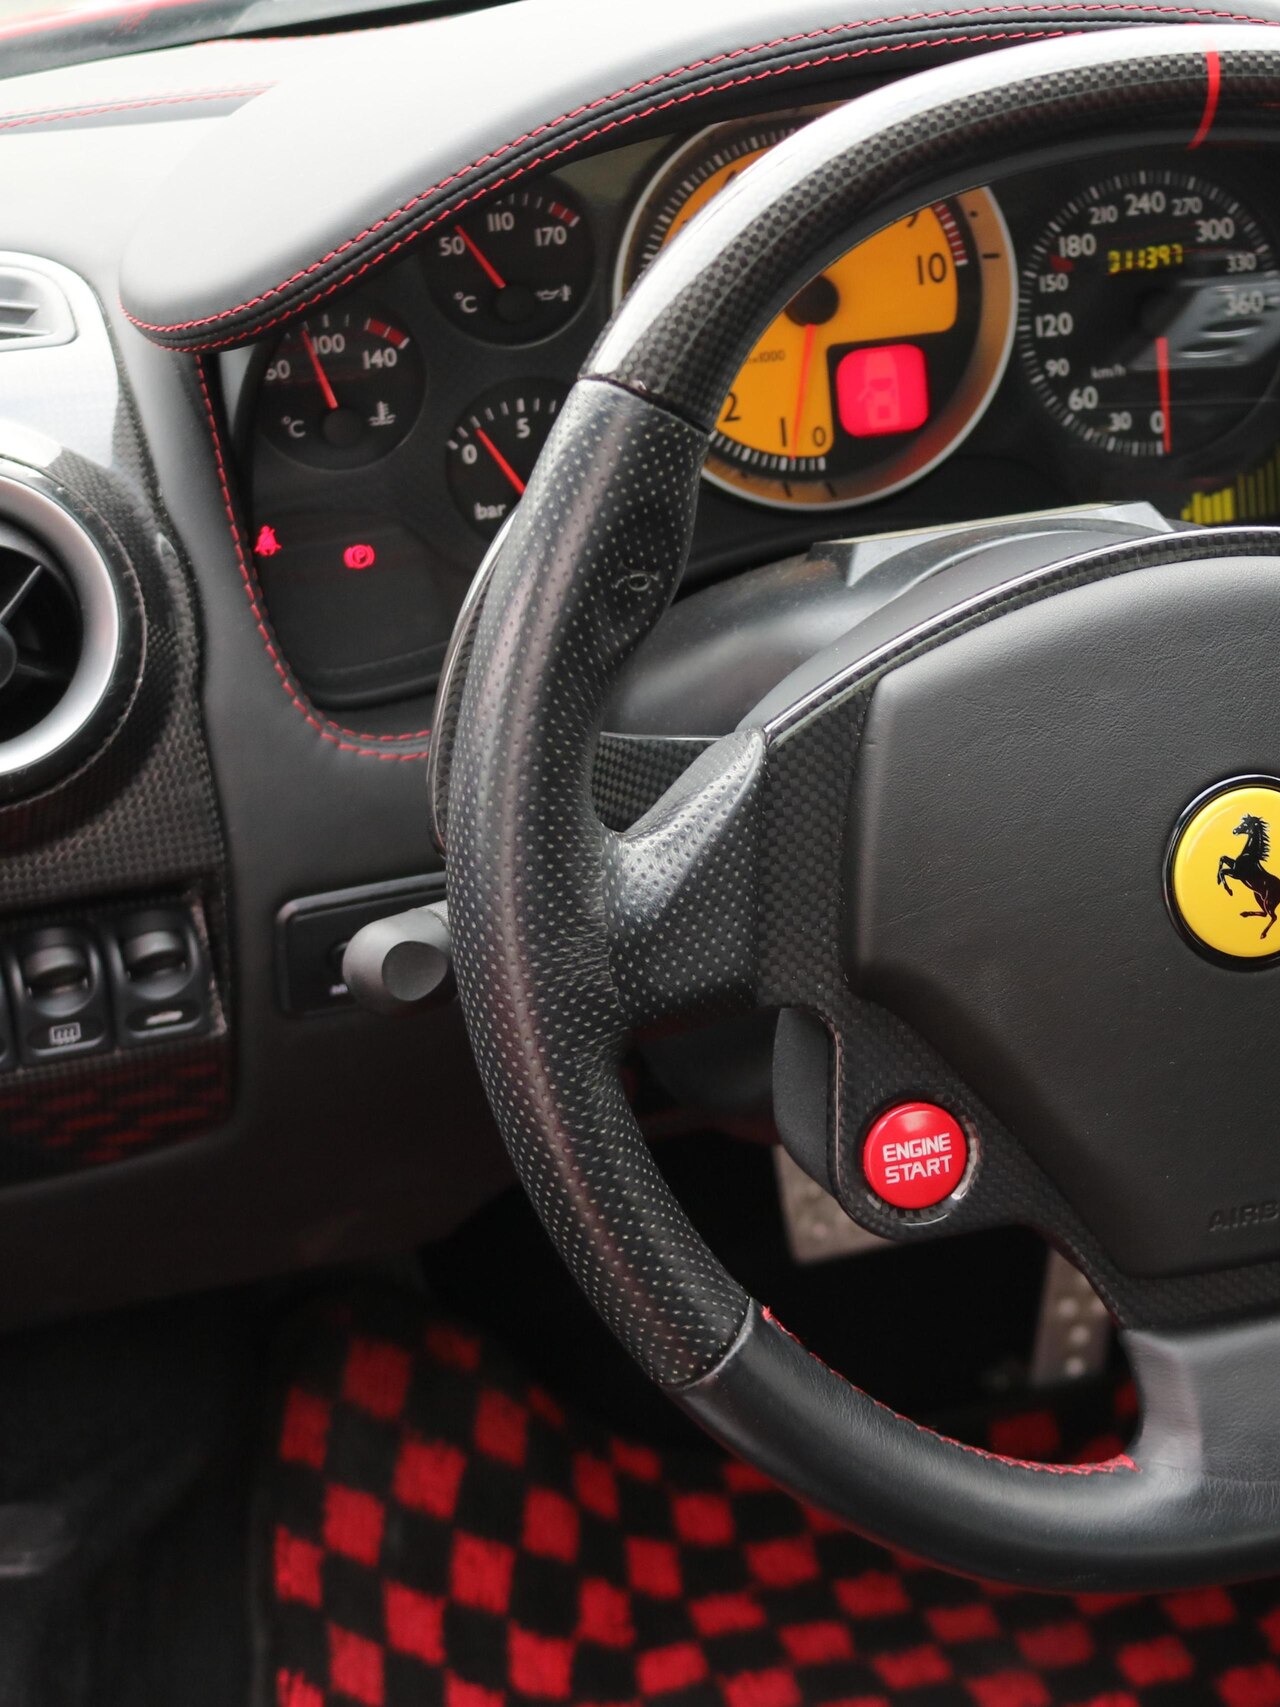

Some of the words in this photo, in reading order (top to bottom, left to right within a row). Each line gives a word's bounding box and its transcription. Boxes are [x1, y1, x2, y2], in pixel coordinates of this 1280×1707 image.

[1125, 191, 1166, 216] 240
[1172, 197, 1203, 215] 270
[487, 211, 514, 232] 110
[1090, 205, 1118, 225] 210
[535, 226, 567, 247] 170
[1196, 218, 1234, 242] 300
[439, 235, 466, 256] 50
[1058, 233, 1096, 257] 180
[917, 252, 947, 285] 10
[1226, 254, 1257, 272] 330
[1040, 274, 1068, 292] 150
[1225, 290, 1265, 316] 360
[1035, 312, 1073, 338] 120
[312, 333, 345, 354] 100
[363, 347, 398, 370] 140
[1046, 358, 1069, 377] 90
[1091, 364, 1126, 379] km/h
[723, 391, 742, 423] 2
[1068, 386, 1098, 411] 60
[516, 417, 531, 439] 5
[780, 416, 788, 448] 1
[1109, 411, 1132, 431] 30
[1150, 410, 1165, 433] 0
[812, 426, 827, 448] 0
[462, 443, 478, 465] 0
[474, 502, 507, 520] bar
[882, 1132, 952, 1162] ENGINE
[885, 1154, 952, 1184] START
